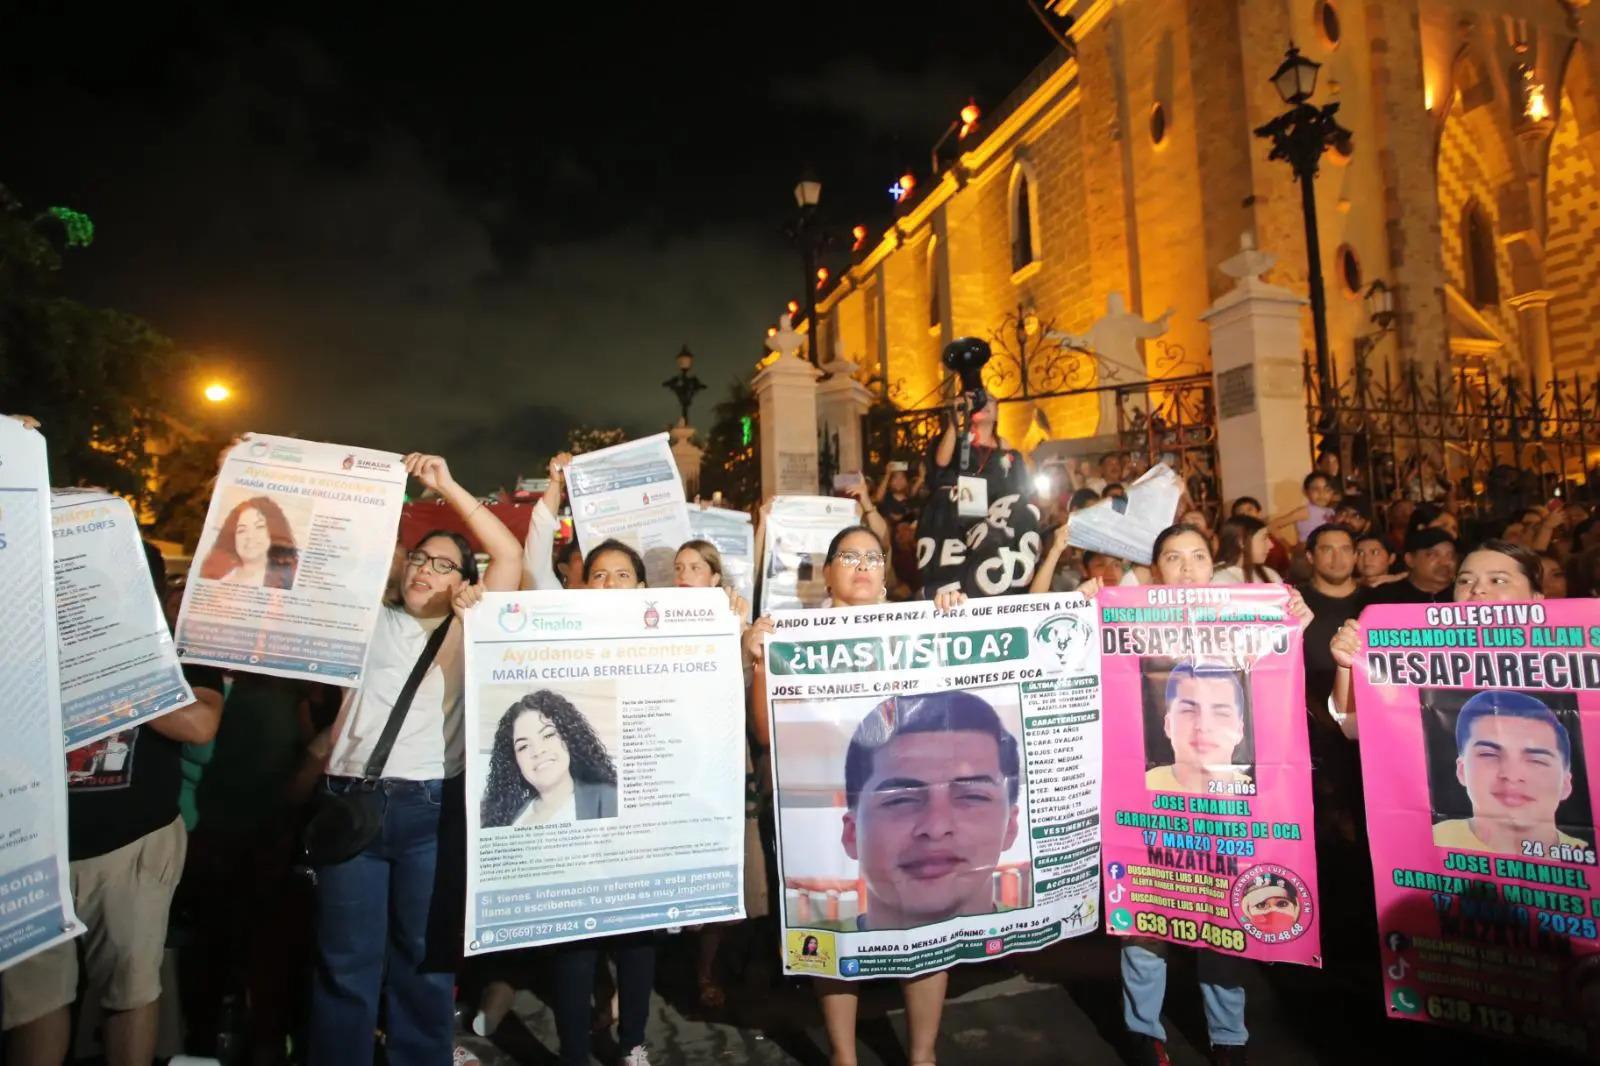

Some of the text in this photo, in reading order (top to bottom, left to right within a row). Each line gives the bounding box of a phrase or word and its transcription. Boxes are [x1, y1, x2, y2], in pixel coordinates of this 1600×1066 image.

[235, 477, 386, 506] MARÍA CECILIA BERRELLEZA FLORES
[76, 520, 117, 534] FLORES
[1147, 588, 1232, 605] COLECTIVO
[532, 618, 582, 633] Sinaloa
[664, 609, 715, 618] SINALOA
[773, 599, 1092, 629] ANDO LUZ Y ESPERANZA PARA QUE REGRESEN A CASA
[1102, 607, 1184, 623] BUSCANDOTE
[1426, 604, 1546, 626] COLECTIVO
[1368, 627, 1600, 647] BUSCANDOTE LUIS ALAN S
[790, 632, 1014, 670] ¿HAS VISTO A?
[492, 661, 718, 681] MARÍA CECILIA BERRELLEZA FLORES
[772, 685, 803, 696] JOSE
[808, 683, 869, 695] EMANUEL
[954, 672, 998, 686] MONTES
[1002, 670, 1014, 681] DE
[1020, 668, 1042, 678] OCA
[1367, 651, 1600, 689] DESAPARECID
[1208, 780, 1256, 796] 24 años
[1153, 795, 1252, 817] JOSE EMANUEL
[1115, 811, 1301, 840] CARRIZALES MONTES DE OCA
[1142, 830, 1254, 857] 17 MARZO 2025
[1521, 840, 1597, 864] 24 años
[1147, 847, 1240, 876] MAZATLAN
[1444, 853, 1590, 890] JOSE EMANUEL
[1127, 864, 1229, 889] BUSCANDOTE LUIS ALAN SM
[1175, 882, 1198, 894] PUERTO
[1267, 866, 1287, 876] LUIS
[1290, 877, 1308, 898] ALAN
[0, 889, 50, 914] tante.
[481, 896, 493, 906] Si
[497, 892, 531, 904] tienes
[536, 885, 599, 898] información
[603, 879, 650, 892] referente
[665, 874, 687, 885] esta
[481, 907, 511, 918] llama
[591, 896, 602, 905] Tu
[605, 891, 636, 905] ayuda
[639, 891, 650, 899] es
[653, 887, 675, 898] muy
[1503, 885, 1585, 915] MONTES
[1591, 898, 1600, 918] D
[1130, 892, 1229, 918] BUSCANDOTE LUIS ALAN SM
[1432, 893, 1454, 911] 17
[1537, 912, 1597, 939] 2025
[508, 921, 579, 940] (669) 327 8424
[1136, 912, 1247, 952] 638 113 4868
[1243, 922, 1304, 943] 638 113 48 68
[857, 944, 900, 953] LLAMADA
[911, 935, 947, 950] MENSAJE
